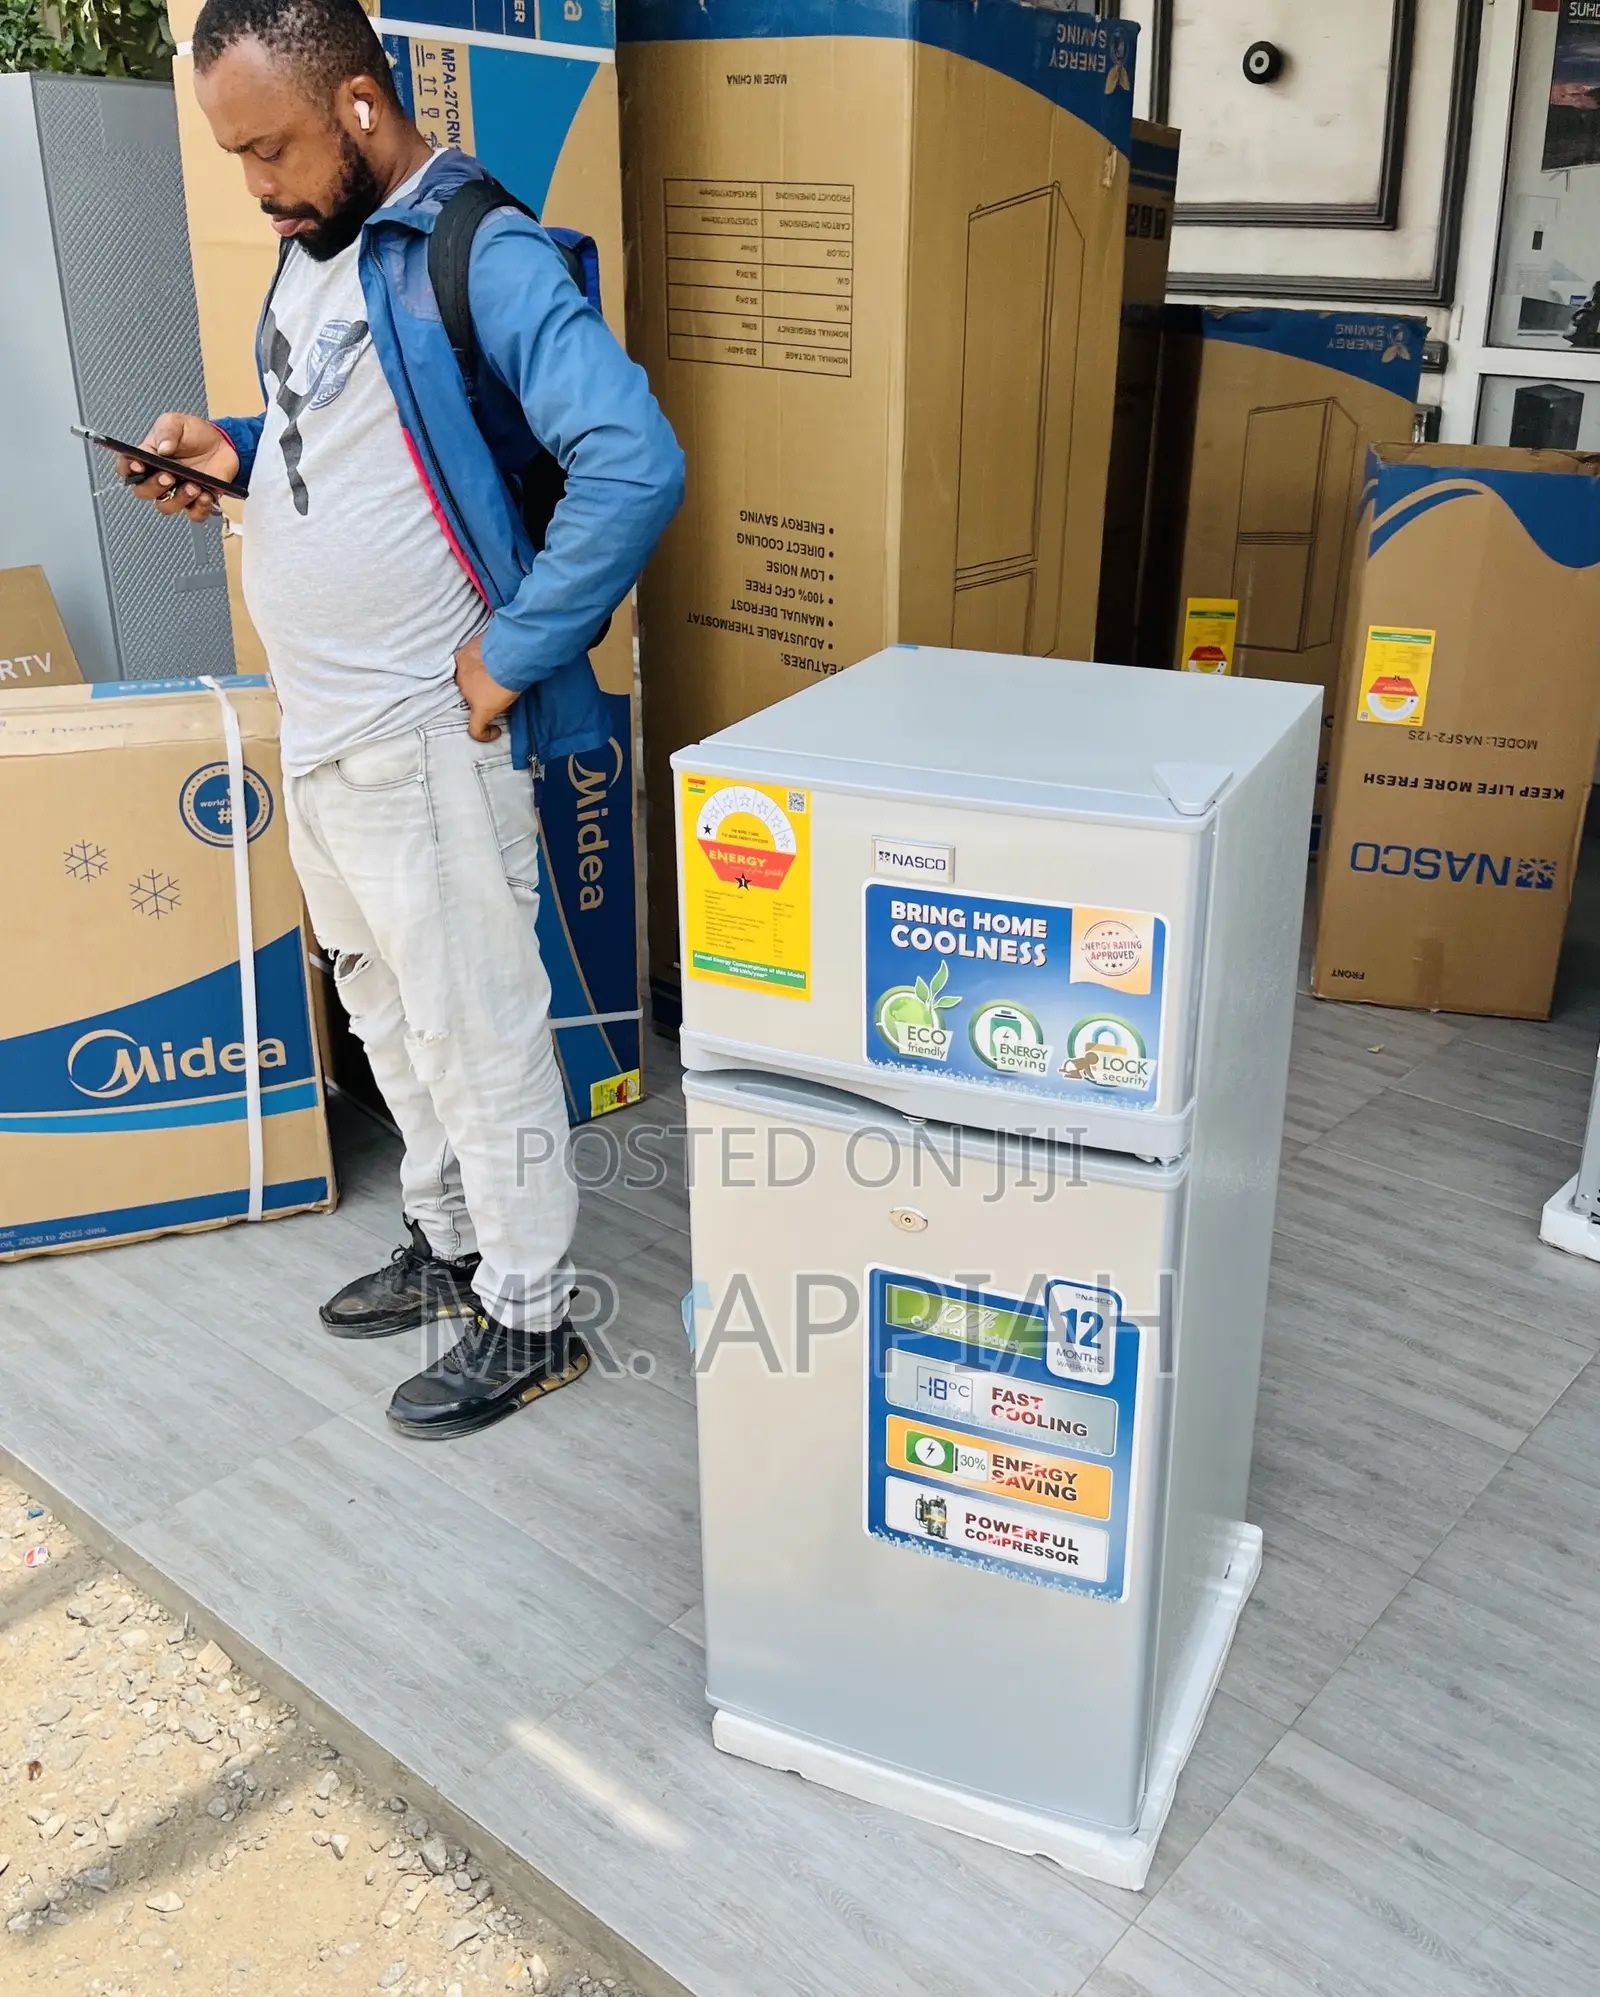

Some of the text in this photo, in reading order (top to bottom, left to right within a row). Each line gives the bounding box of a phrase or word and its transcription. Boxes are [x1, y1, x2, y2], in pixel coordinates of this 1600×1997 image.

[1056, 23, 1107, 49] SAVING
[1048, 47, 1106, 73] ENERGY
[727, 74, 787, 85] MADE IN CHINA
[776, 192, 816, 202] DIMENSIONS
[818, 193, 850, 203] PRODUCT
[779, 219, 820, 229] DIMENSIONS
[821, 221, 850, 230] CARTON
[826, 249, 850, 258] COLOR
[777, 325, 816, 335] FREQUENCY
[818, 328, 849, 338] NOMINAL
[1335, 323, 1385, 337] SAVING
[1326, 338, 1383, 351] ENERGY
[785, 352, 815, 363] VOLTAGE
[817, 354, 848, 365] NOMINAL
[739, 510, 825, 535] ENERGY SAVING
[736, 533, 825, 559] DIRECT COOLING
[766, 560, 825, 582] LOW NOISE
[745, 579, 825, 604] 100% CFC FREE
[730, 599, 825, 628] MANUAL DEFROST
[687, 611, 824, 650] ADJUSTABLE THERMOSTAT
[1407, 729, 1539, 751] MODEL: NASF2-12S
[1363, 772, 1565, 800] KEEP LIFE MORE FRESH
[567, 736, 624, 912] Midea
[708, 849, 767, 868] ENERGY
[892, 853, 947, 871] NASCO
[1349, 841, 1512, 887] NASCO
[890, 899, 1048, 939] BRING HOME
[890, 924, 1048, 968] COOLNESS
[1113, 940, 1142, 949] RATING
[1090, 950, 1135, 960] APPROVED
[1331, 968, 1365, 981] FRONT
[907, 1025, 947, 1044] ECO
[907, 1041, 946, 1060] friendly
[999, 1043, 1048, 1060] ENERGY
[67, 1028, 288, 1099] Midea
[1000, 1056, 1047, 1072] saving
[1102, 1055, 1148, 1076] LOCK
[1102, 1072, 1148, 1088] security
[1080, 1294, 1114, 1307] NASCO
[939, 1302, 998, 1329] 100%
[911, 1315, 966, 1338] Original
[1060, 1308, 1104, 1350] 12
[1056, 1348, 1105, 1366] MONTHS
[1056, 1360, 1105, 1374] WARRANTY
[991, 1386, 1044, 1410] FAST
[990, 1404, 1088, 1437] COOLING
[960, 1453, 986, 1472] 30%
[992, 1454, 1078, 1485] ENERGY
[991, 1470, 1078, 1501] SAVING
[965, 1512, 1080, 1552] POWERFUL
[964, 1528, 1079, 1566] COMPRESSOR
